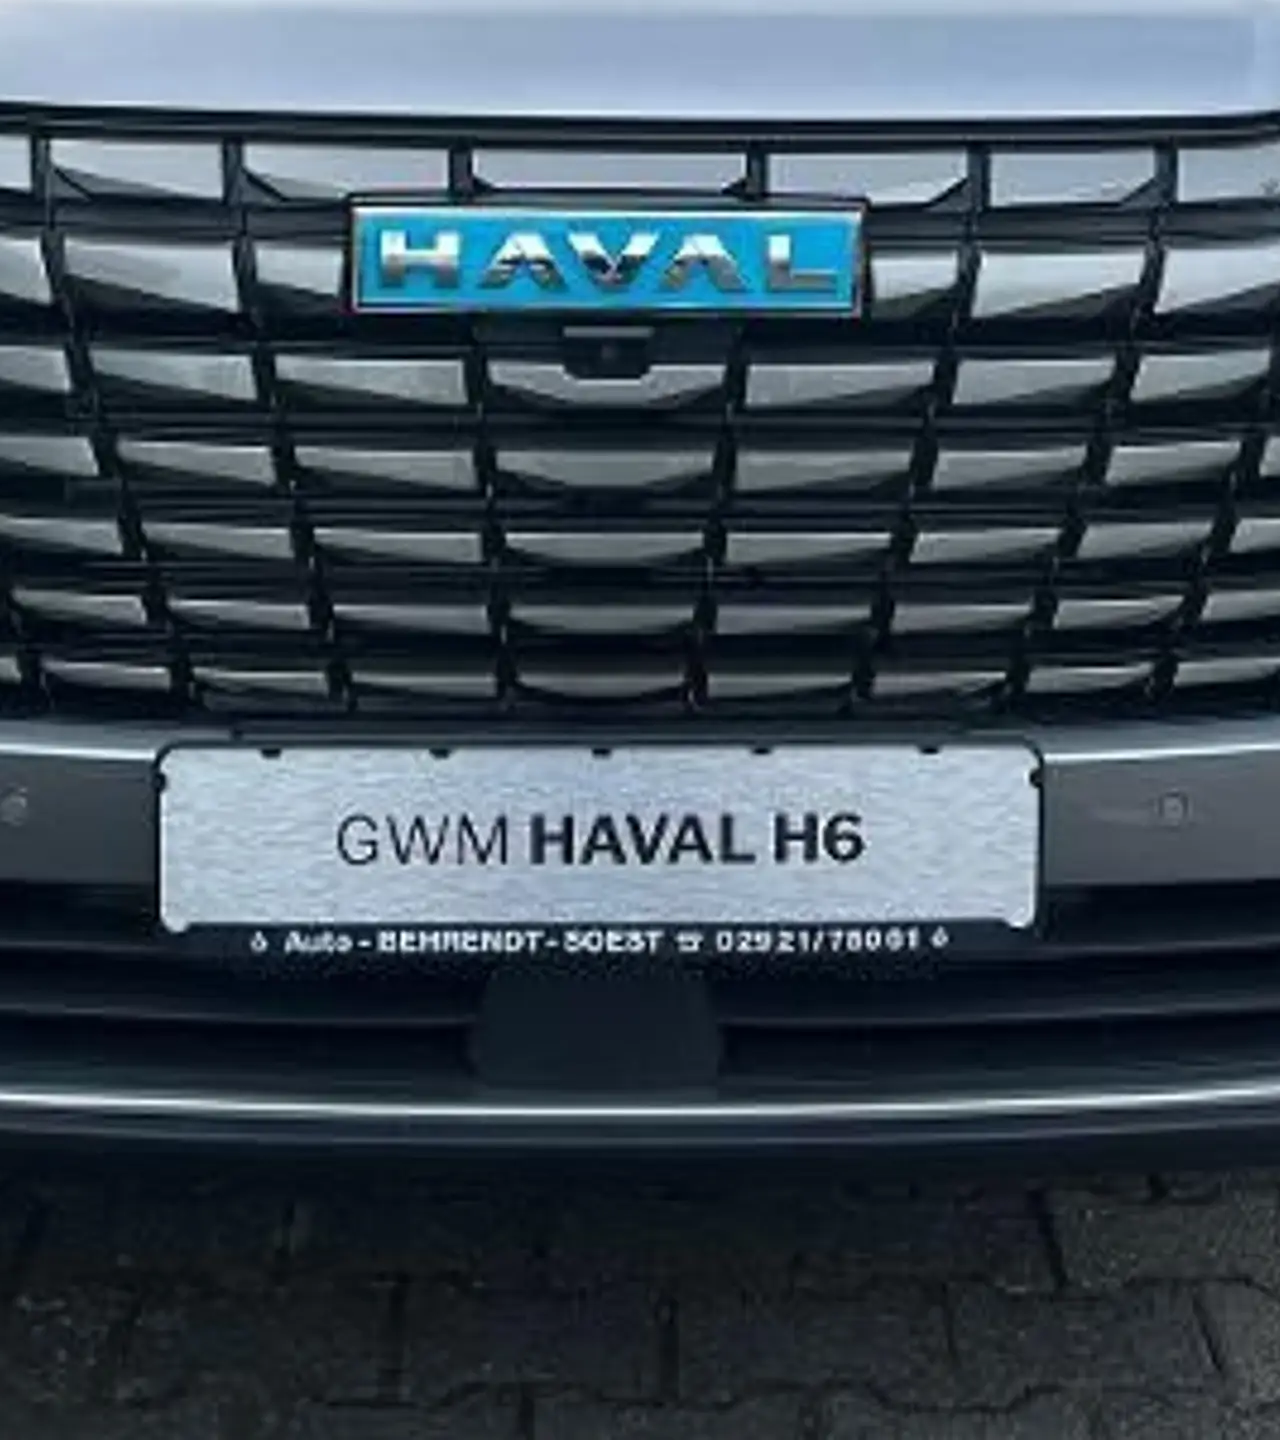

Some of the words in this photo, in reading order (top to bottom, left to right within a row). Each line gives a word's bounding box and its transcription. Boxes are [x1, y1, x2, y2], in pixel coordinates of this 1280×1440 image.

[378, 229, 838, 293] HAVAL
[336, 812, 508, 866] GWM
[529, 811, 757, 866] HAVAL
[773, 810, 867, 865] H6
